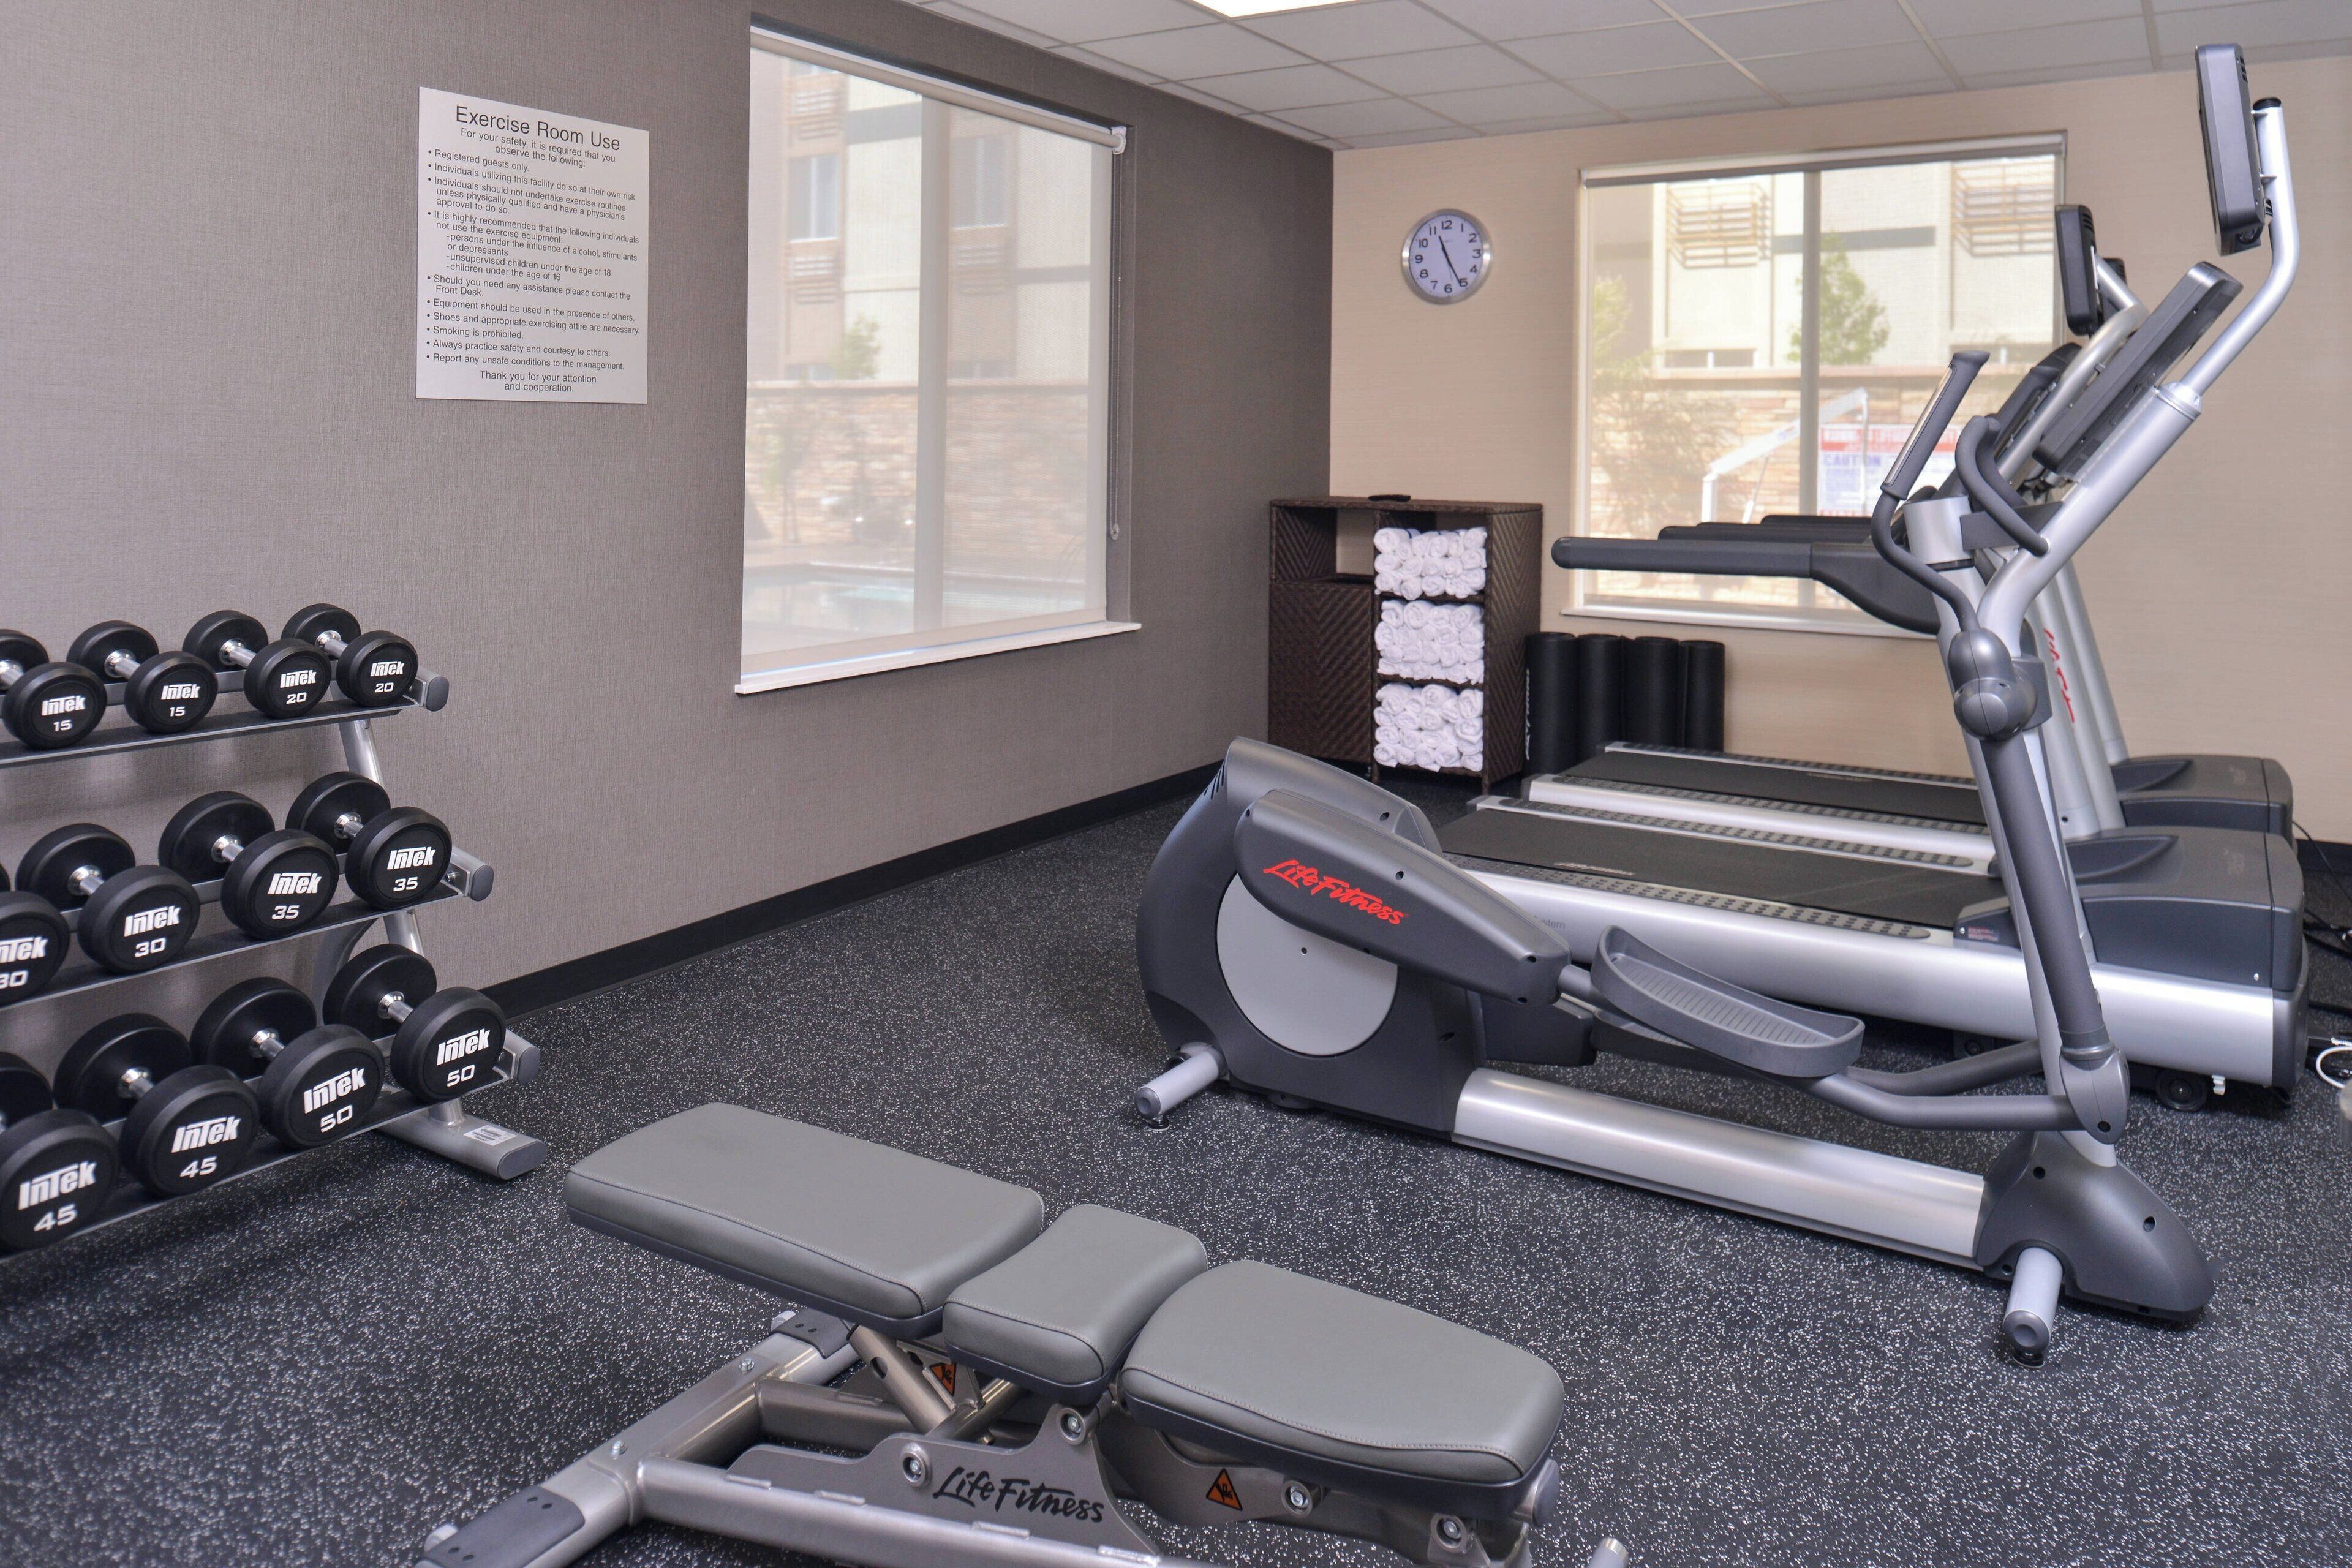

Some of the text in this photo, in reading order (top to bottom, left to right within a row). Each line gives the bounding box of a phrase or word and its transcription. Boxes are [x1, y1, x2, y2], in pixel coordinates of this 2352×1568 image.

[456, 105, 620, 151] Exercise Room Use
[461, 127, 616, 163] For your safety, it is required that you
[435, 149, 529, 173] Registered guests only.
[496, 145, 585, 169] observe the following:
[435, 162, 479, 177] Individuals
[482, 171, 511, 184] utilizing
[514, 175, 528, 184] this
[530, 177, 554, 190] facility
[589, 187, 605, 196] their
[624, 192, 637, 201] risk.
[435, 176, 478, 190] Individuals
[482, 184, 508, 195] should
[526, 192, 563, 203] undertake
[566, 197, 596, 207] exercise
[598, 202, 626, 211] routines
[436, 198, 472, 209] approval
[1429, 226, 1436, 235] 11
[1442, 221, 1452, 230] 12
[1419, 238, 1428, 248] 10
[1469, 233, 1477, 243] 2
[459, 244, 508, 256] depressants
[527, 241, 560, 252] influence
[573, 247, 600, 258] alcohol,
[603, 251, 638, 262] stimulants
[1415, 254, 1423, 263] 9
[1472, 249, 1482, 258] 3
[486, 267, 509, 276] under
[526, 272, 540, 281] age
[508, 259, 538, 269] children
[565, 265, 576, 273] the
[579, 268, 592, 276] age
[1420, 269, 1428, 278] 8
[1470, 265, 1477, 273] 4
[434, 274, 463, 285] Should
[507, 283, 521, 292] any
[523, 284, 563, 294] assistance
[566, 287, 590, 296] please
[592, 290, 617, 299] contact
[436, 285, 483, 296] Front Desk.
[1430, 281, 1438, 289] 7
[1444, 284, 1453, 293] 6
[1460, 278, 1468, 287] 5
[434, 298, 478, 309] Equipment
[481, 303, 507, 312] should
[510, 304, 520, 313] be
[611, 313, 635, 322] others.
[433, 326, 470, 338] Smoking
[483, 330, 523, 339] prohibited.
[434, 312, 461, 322] Shoes
[481, 317, 526, 326] appropriate
[529, 320, 567, 331] exercising
[603, 326, 640, 336] necessary.
[433, 339, 462, 350] Always
[466, 342, 497, 351] practice
[500, 344, 524, 354] safety
[543, 347, 575, 356] courtesy
[433, 353, 462, 364] Report
[464, 356, 480, 365] any
[511, 358, 551, 366] conditions
[576, 362, 624, 371] management.
[480, 370, 507, 380] Thank
[510, 373, 525, 382] you
[528, 372, 539, 381] for
[562, 374, 597, 383] attention
[504, 382, 574, 393] and cooperation.
[371, 661, 404, 676] InTek
[280, 670, 316, 688] InTek
[375, 682, 394, 692] 20
[161, 684, 200, 699] InTek
[286, 692, 307, 704] 20
[42, 696, 85, 715] InTek
[170, 707, 185, 716] 15
[54, 720, 72, 731] 15
[387, 847, 435, 869] InTek
[268, 873, 322, 894] InTek
[393, 877, 418, 891] 35
[1263, 859, 1404, 925] Life Fitness
[272, 905, 300, 919] 35
[124, 906, 180, 937] InTek
[0, 937, 48, 963] nTek
[135, 938, 166, 957] 30
[437, 1028, 490, 1065] InTek
[447, 1065, 475, 1087] 50
[304, 1068, 365, 1114] InTek
[321, 1105, 352, 1132] 50
[172, 1117, 241, 1153] InTek
[180, 1156, 216, 1177] 45
[19, 1161, 96, 1210] InTek
[34, 1204, 77, 1231] 45
[932, 1466, 1104, 1523] Life Fitness
